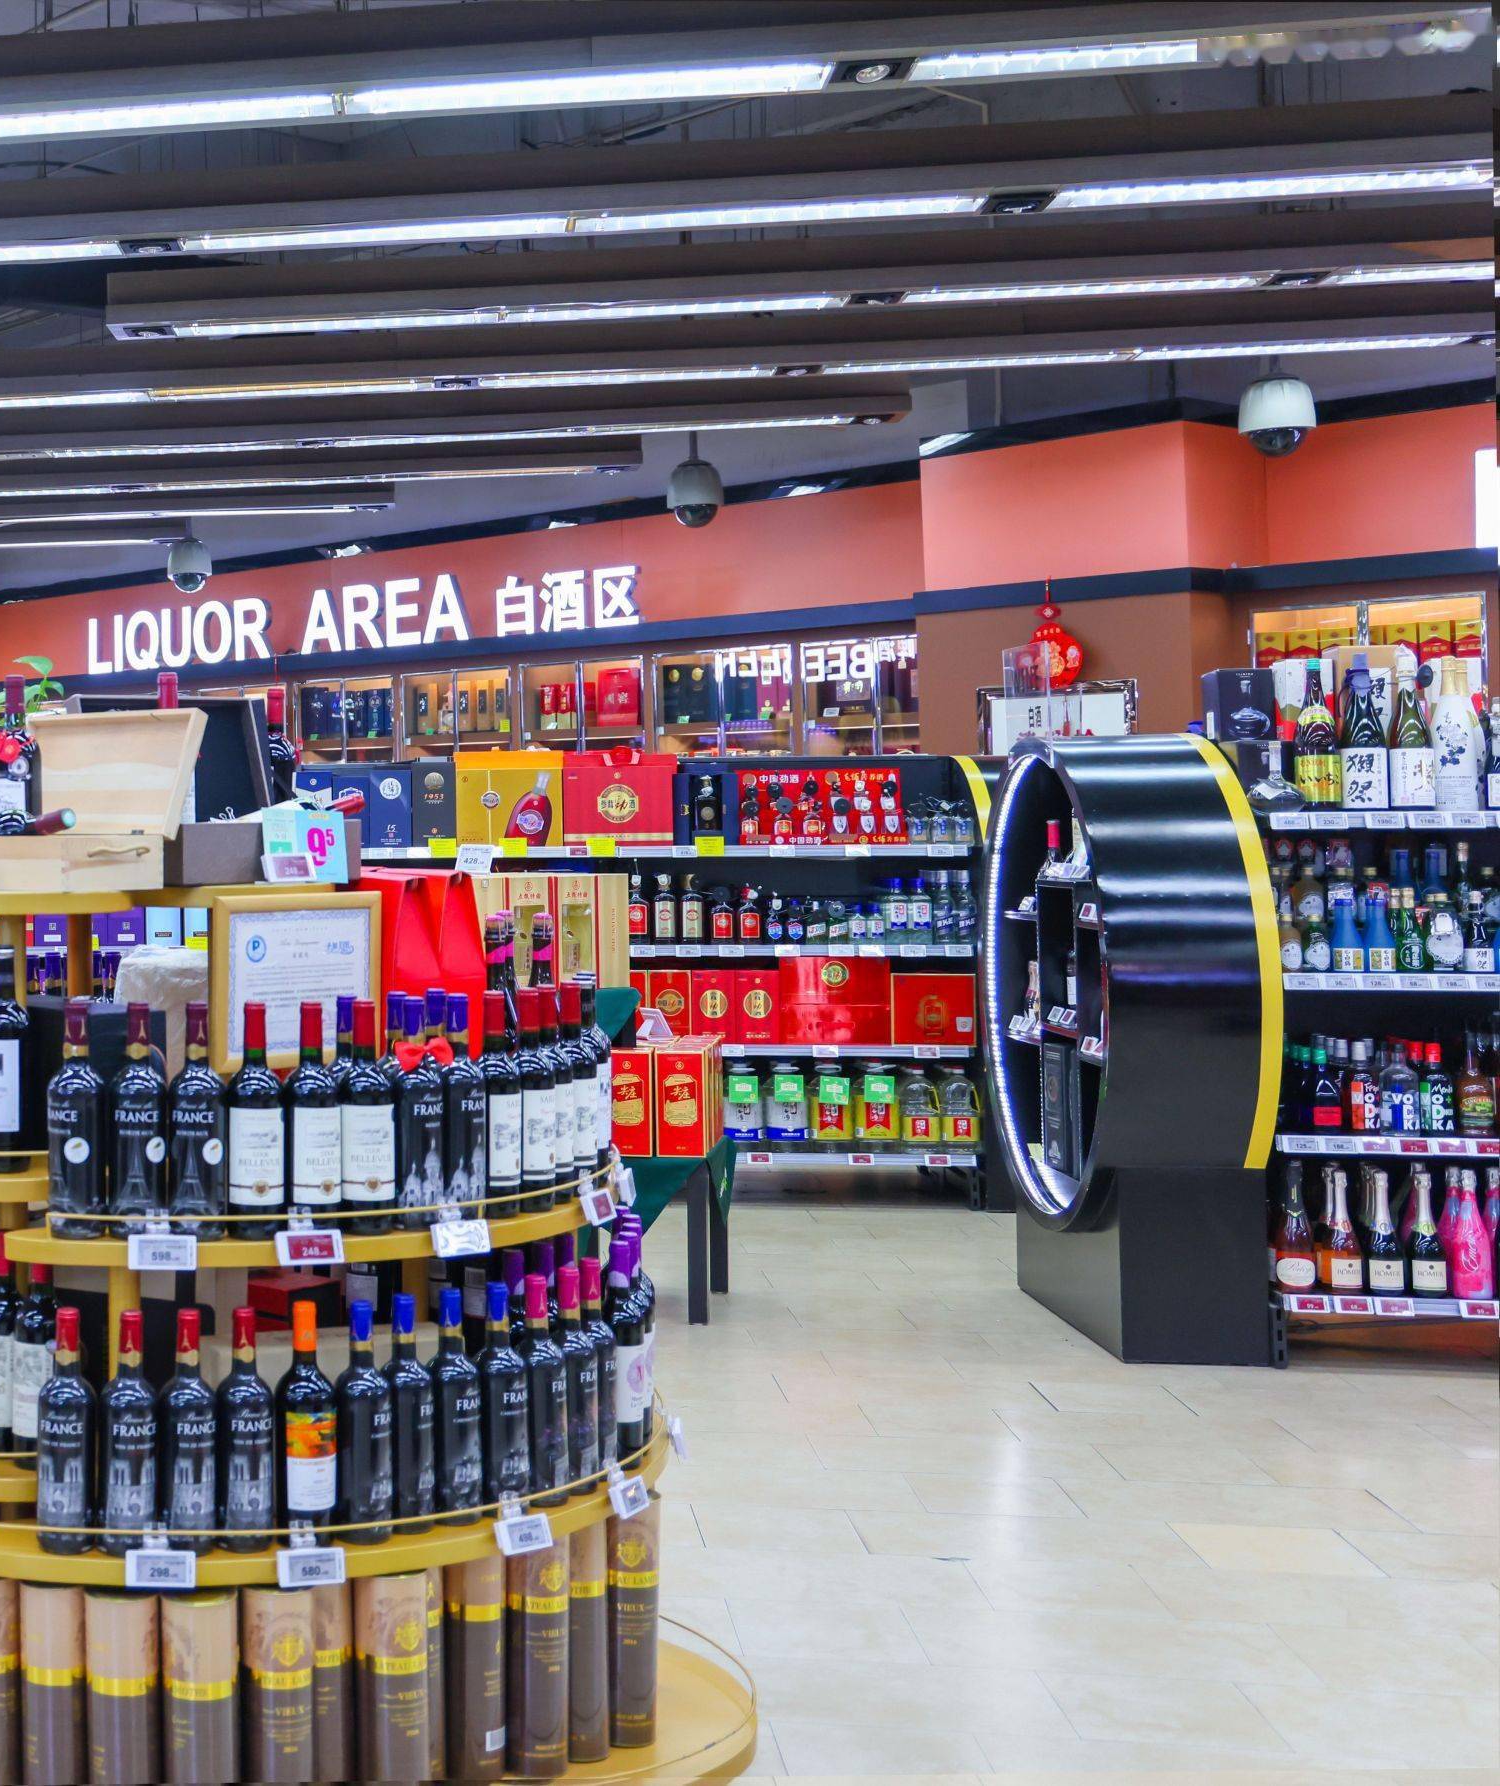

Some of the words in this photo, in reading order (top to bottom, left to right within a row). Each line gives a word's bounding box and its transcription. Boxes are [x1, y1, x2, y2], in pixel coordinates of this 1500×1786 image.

[495, 565, 640, 637] 白酒区
[87, 597, 271, 674] LIQUOR
[301, 573, 469, 655] AREA
[670, 1085, 691, 1101] 尖庄
[114, 1109, 160, 1123] FRANCE
[172, 1109, 215, 1123] FRANCE
[40, 1420, 83, 1435] FRANCE
[113, 1422, 157, 1437] FRANCE
[177, 1422, 216, 1437] FRANCE
[231, 1418, 273, 1433] FRANCE
[617, 1602, 645, 1612] VIEUX
[274, 1705, 304, 1717] VIEUX
